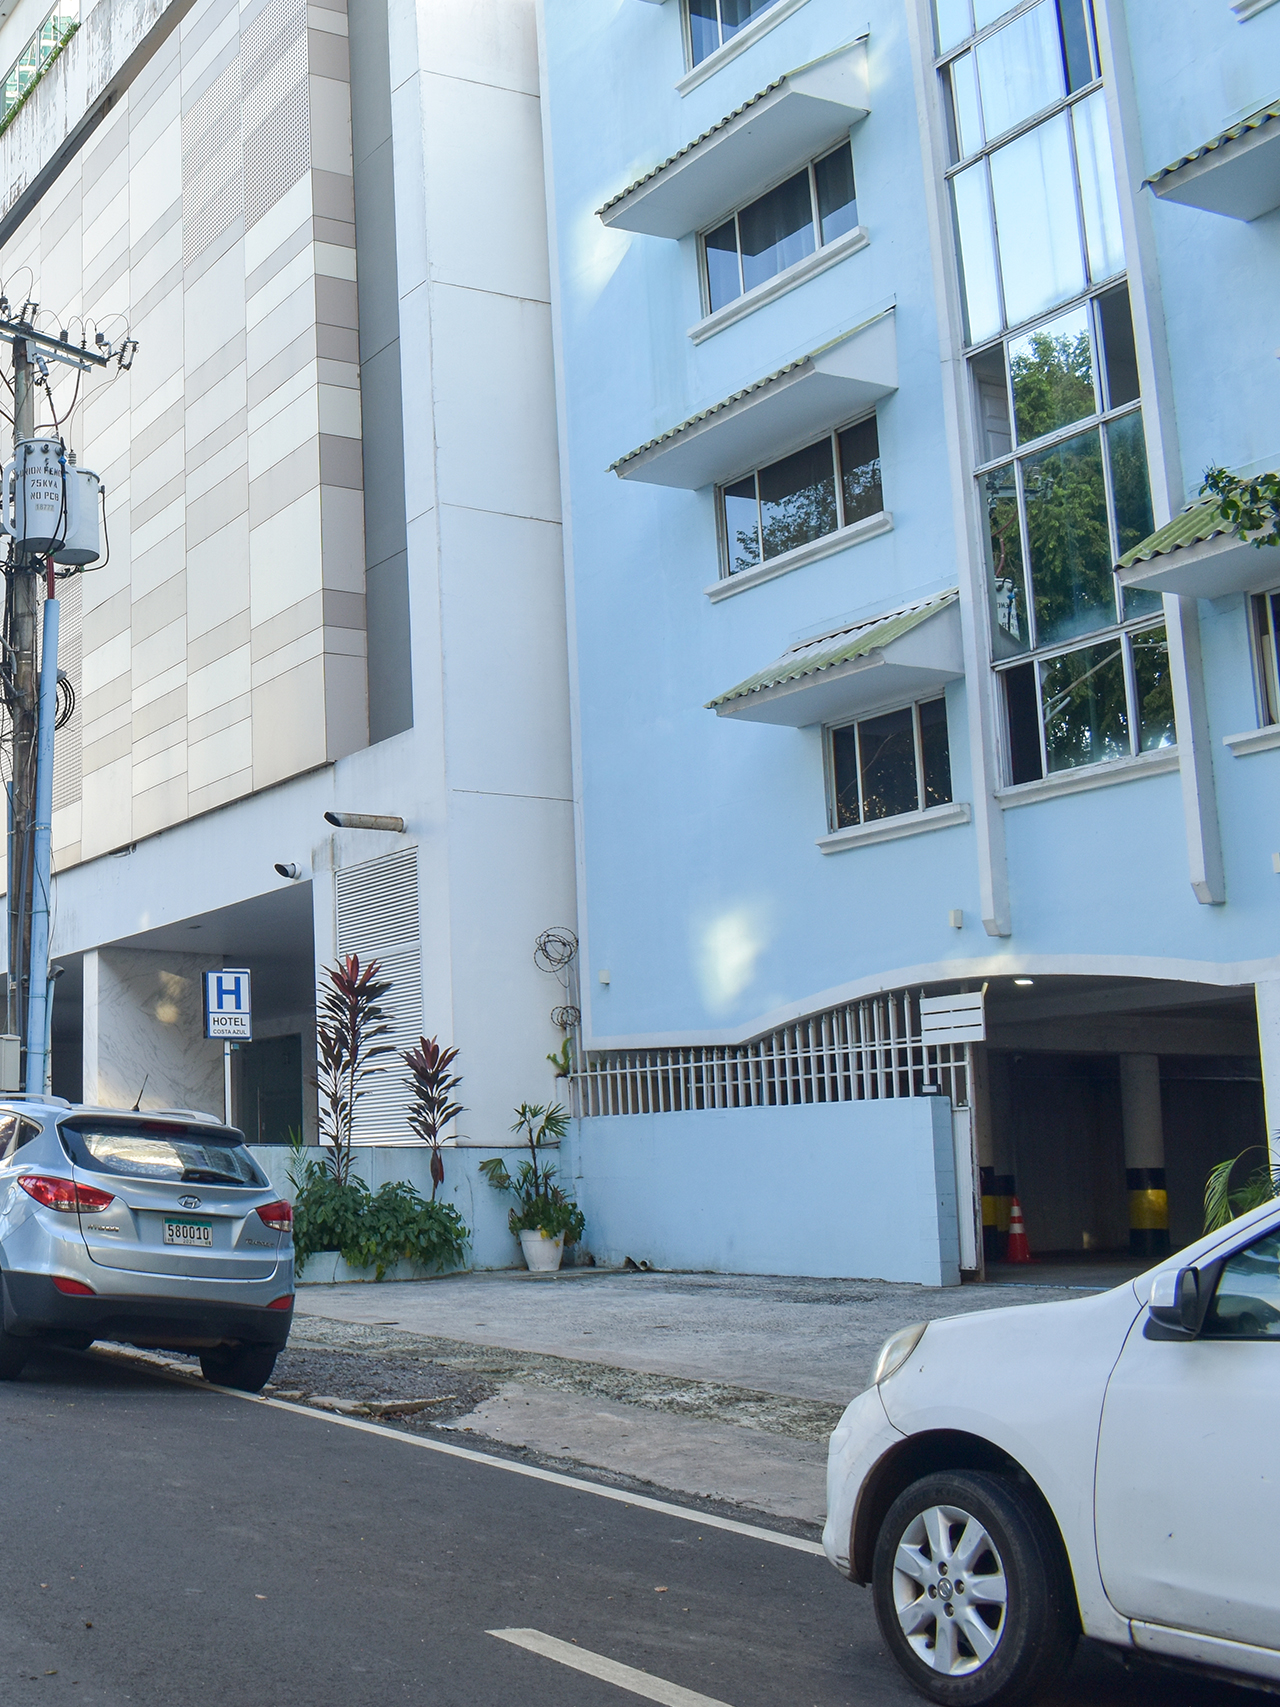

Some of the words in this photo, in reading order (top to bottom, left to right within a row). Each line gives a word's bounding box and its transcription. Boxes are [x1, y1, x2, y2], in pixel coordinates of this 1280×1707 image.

[30, 479, 58, 489] 75KVA
[30, 491, 42, 500] NO
[44, 491, 59, 502] PCB
[217, 976, 241, 1009] H
[213, 1017, 246, 1026] HOTEL
[167, 1224, 209, 1240] 580010
